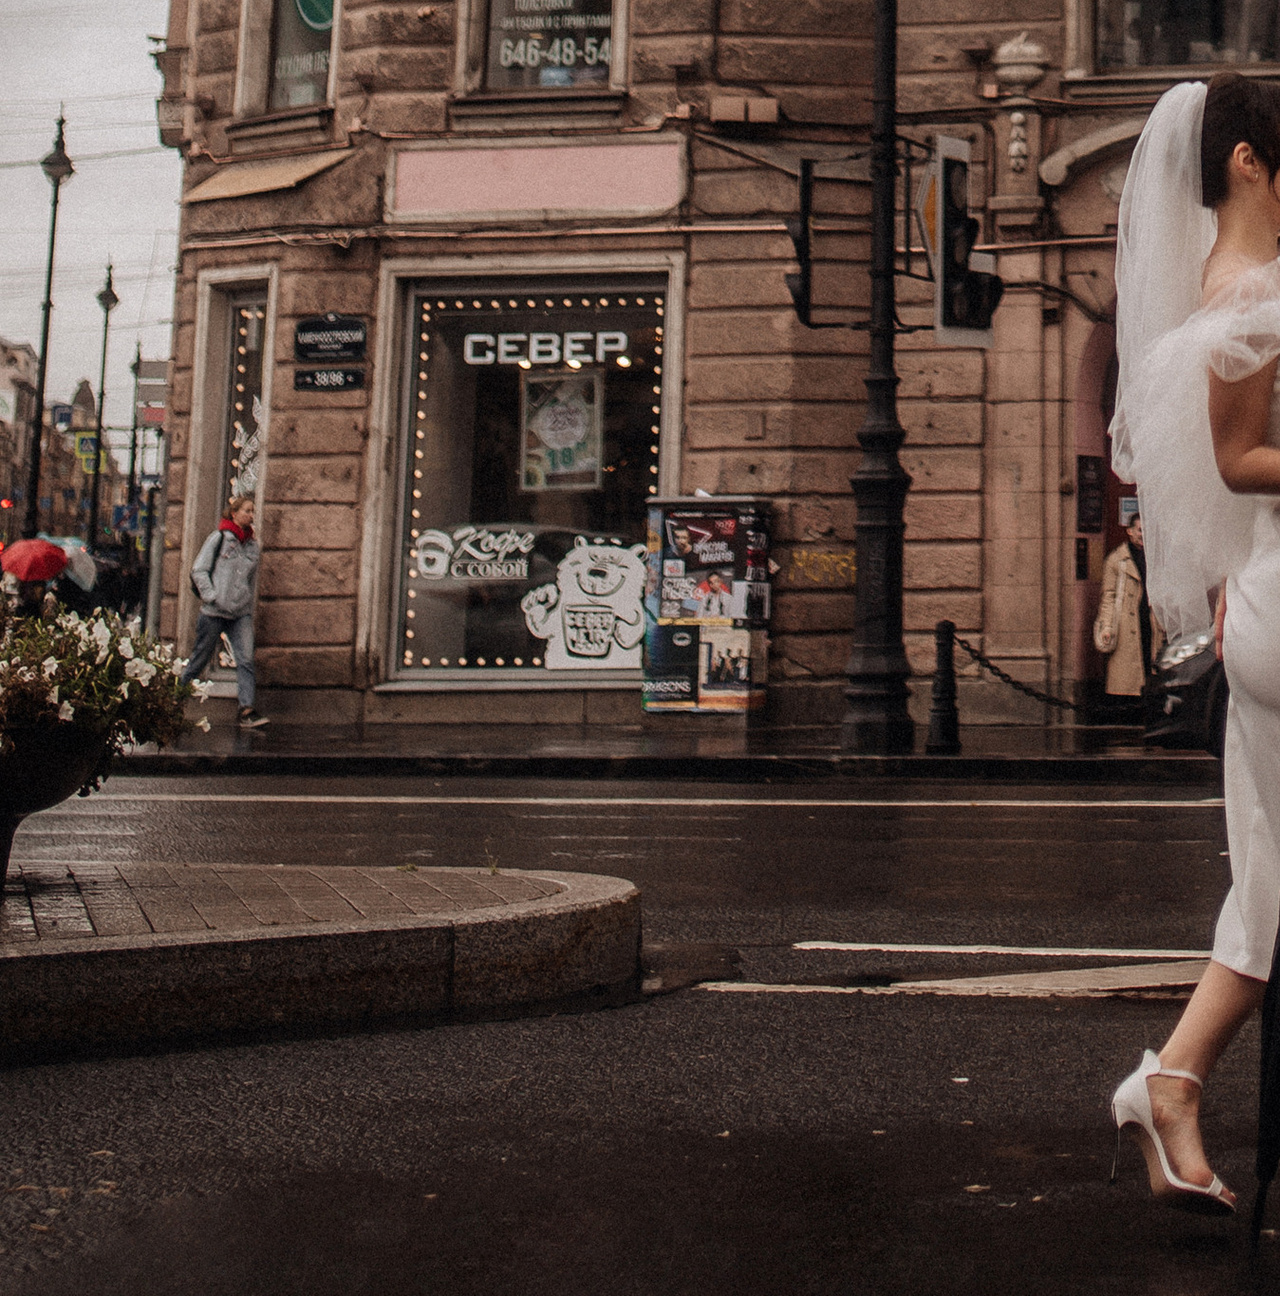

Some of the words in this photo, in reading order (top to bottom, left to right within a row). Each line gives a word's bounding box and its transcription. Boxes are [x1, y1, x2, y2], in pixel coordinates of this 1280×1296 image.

[499, 37, 612, 67] 646-48-54
[464, 331, 628, 365] СЕВЕР
[452, 526, 535, 561] Кофе
